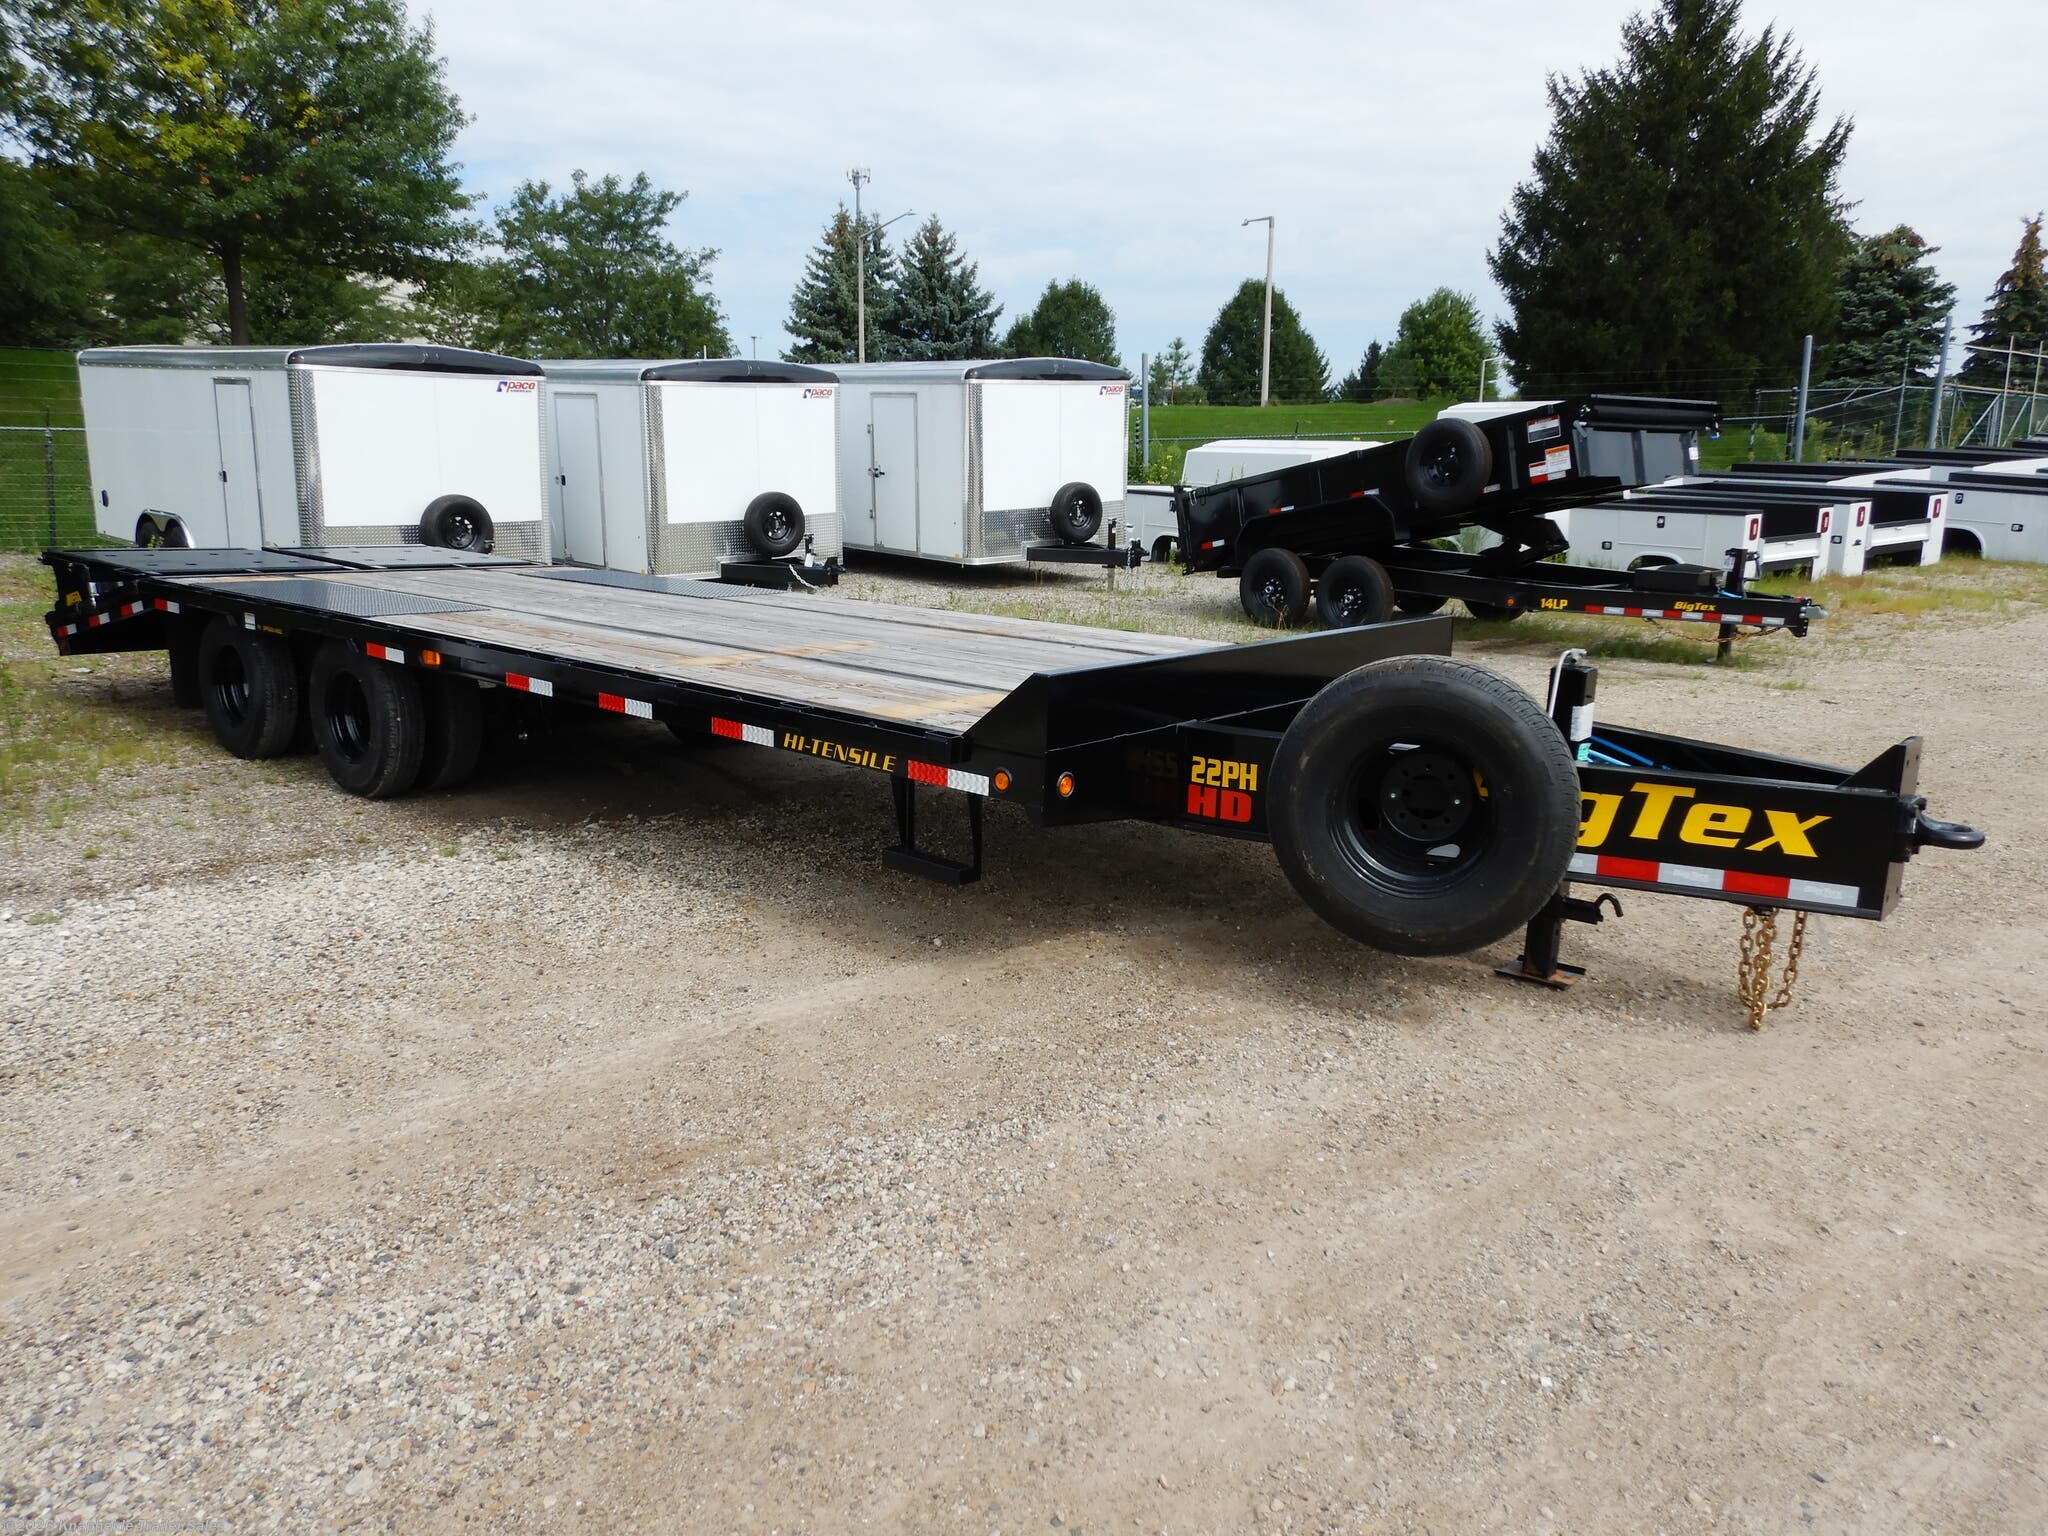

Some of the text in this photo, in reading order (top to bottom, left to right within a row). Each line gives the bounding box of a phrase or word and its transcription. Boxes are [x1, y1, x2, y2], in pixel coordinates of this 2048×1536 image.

[1539, 597, 1568, 610] 14LP
[1673, 600, 1717, 612] BigTex
[783, 732, 897, 773] HI-TENSILE
[1190, 755, 1258, 791] 22PH
[1187, 784, 1253, 823] HD
[1577, 782, 1833, 859] gTex
